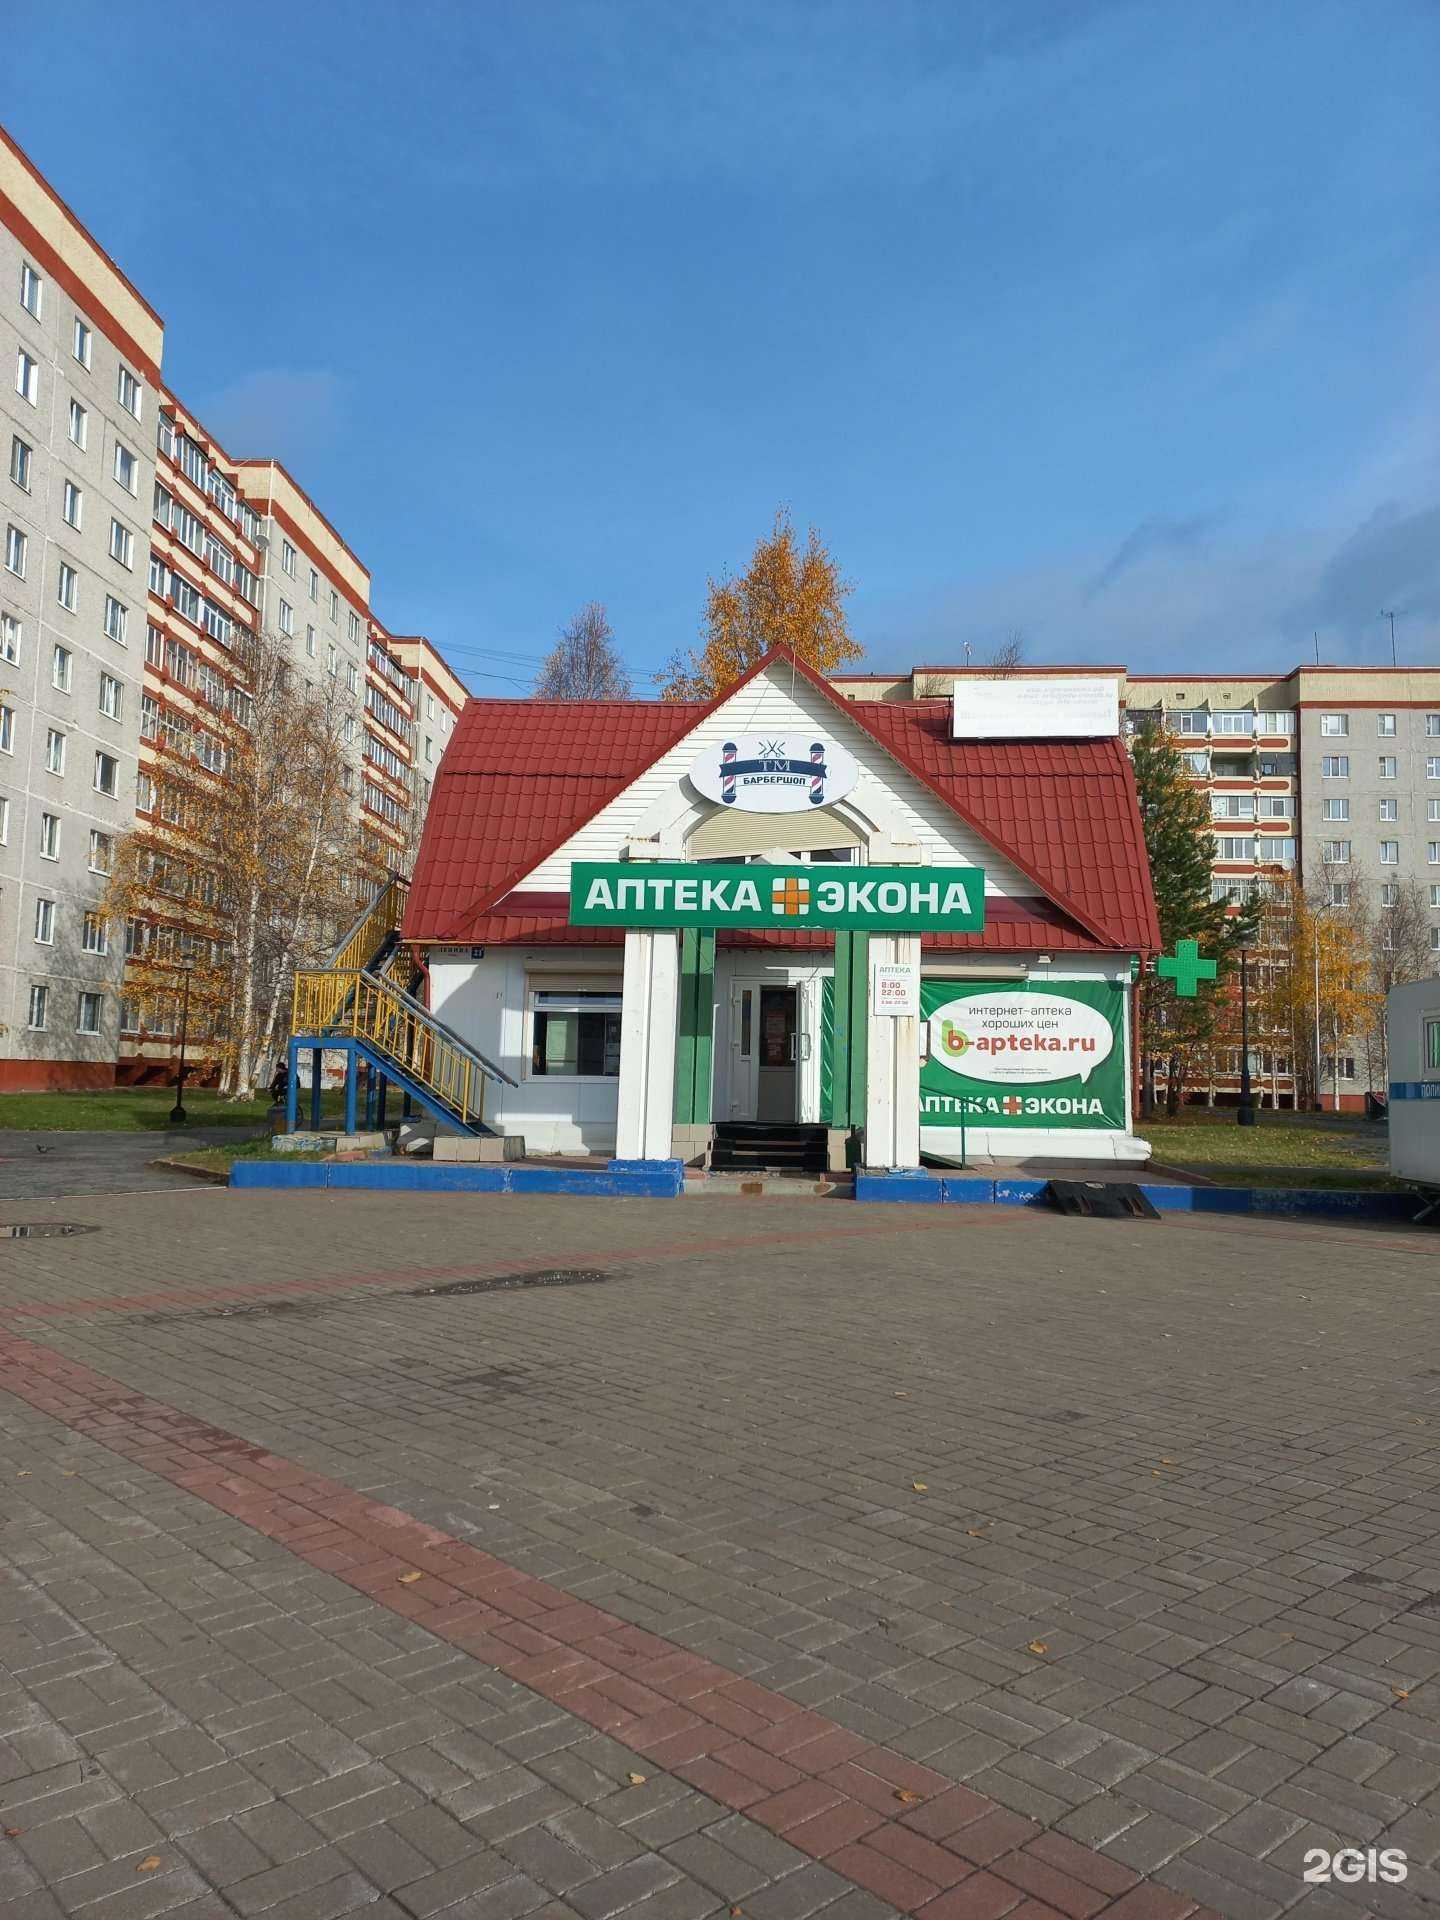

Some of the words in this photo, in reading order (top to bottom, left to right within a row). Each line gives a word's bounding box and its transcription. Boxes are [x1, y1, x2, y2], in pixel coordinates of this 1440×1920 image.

[743, 776, 806, 785] БАРБЕРШОП
[584, 878, 762, 912] АПТЕКА
[816, 881, 973, 914] ЭКОНА
[968, 1006, 1072, 1016] интернет-аптека
[981, 1018, 1034, 1029] хороших
[1037, 1018, 1059, 1029] цен
[947, 1030, 1095, 1055] b-apteka.ru
[1025, 1098, 1104, 1115] ЭКОНА
